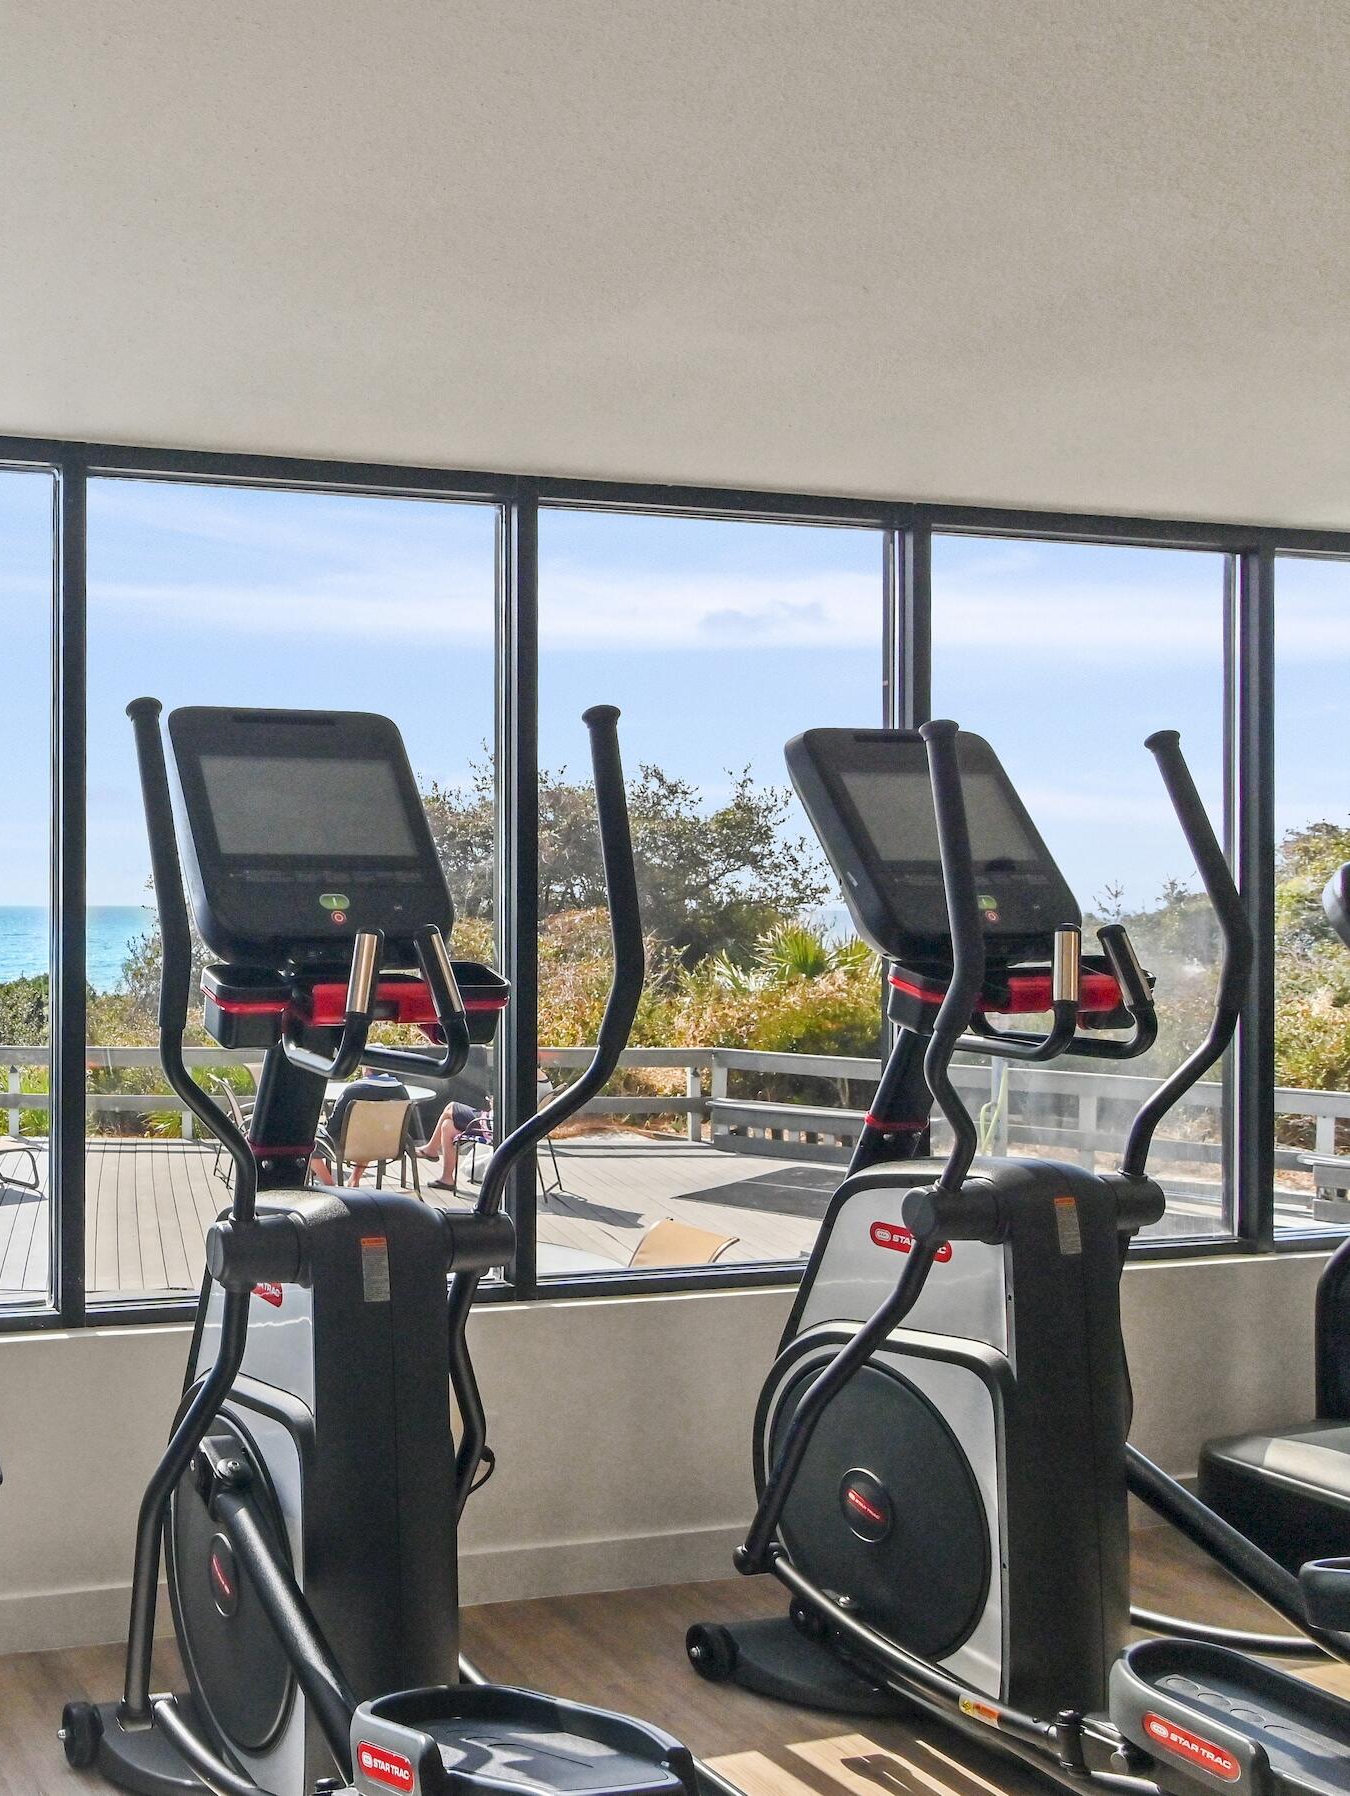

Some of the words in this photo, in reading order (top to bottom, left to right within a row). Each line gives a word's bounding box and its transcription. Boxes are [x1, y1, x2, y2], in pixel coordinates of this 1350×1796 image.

[1170, 1732, 1200, 1753] STAR
[1200, 1747, 1232, 1770] TRAC
[373, 1758, 391, 1772] STAR
[390, 1765, 410, 1780] TRAC
